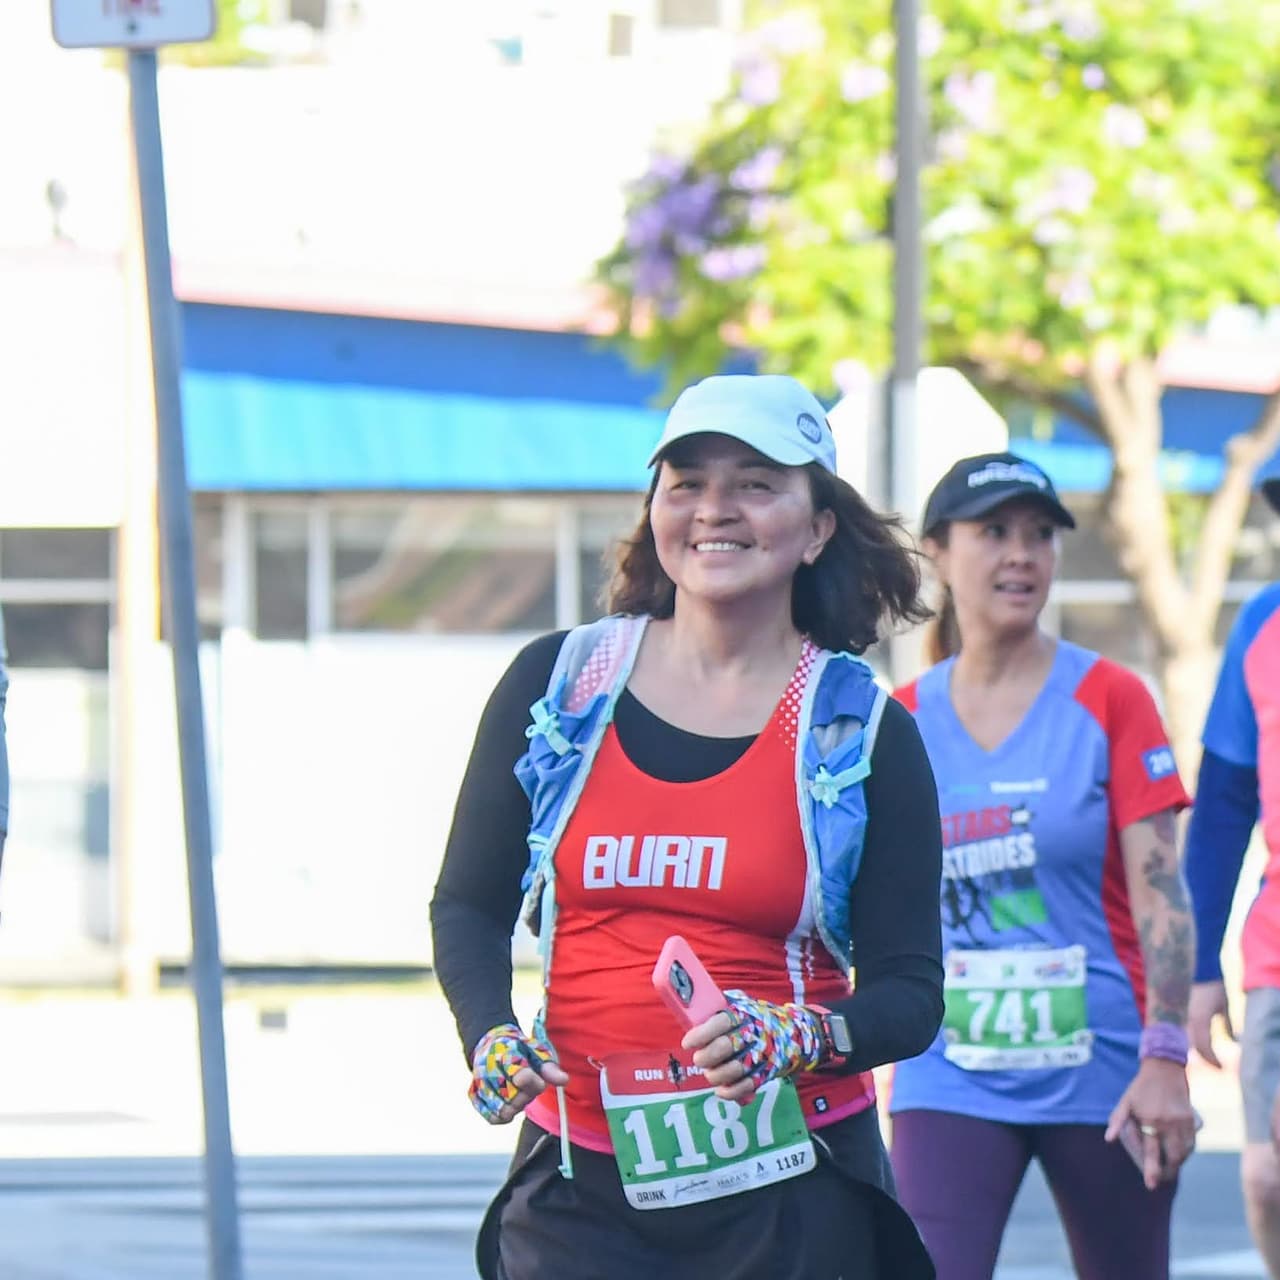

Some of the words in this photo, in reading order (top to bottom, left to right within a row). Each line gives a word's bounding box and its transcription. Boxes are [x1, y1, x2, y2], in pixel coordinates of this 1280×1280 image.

[583, 835, 728, 890] BURN
[967, 990, 1057, 1044] 741
[634, 1069, 663, 1081] RUN
[624, 1078, 780, 1175] 1187
[776, 1151, 806, 1171] 1187
[636, 1189, 667, 1203] DRINK
